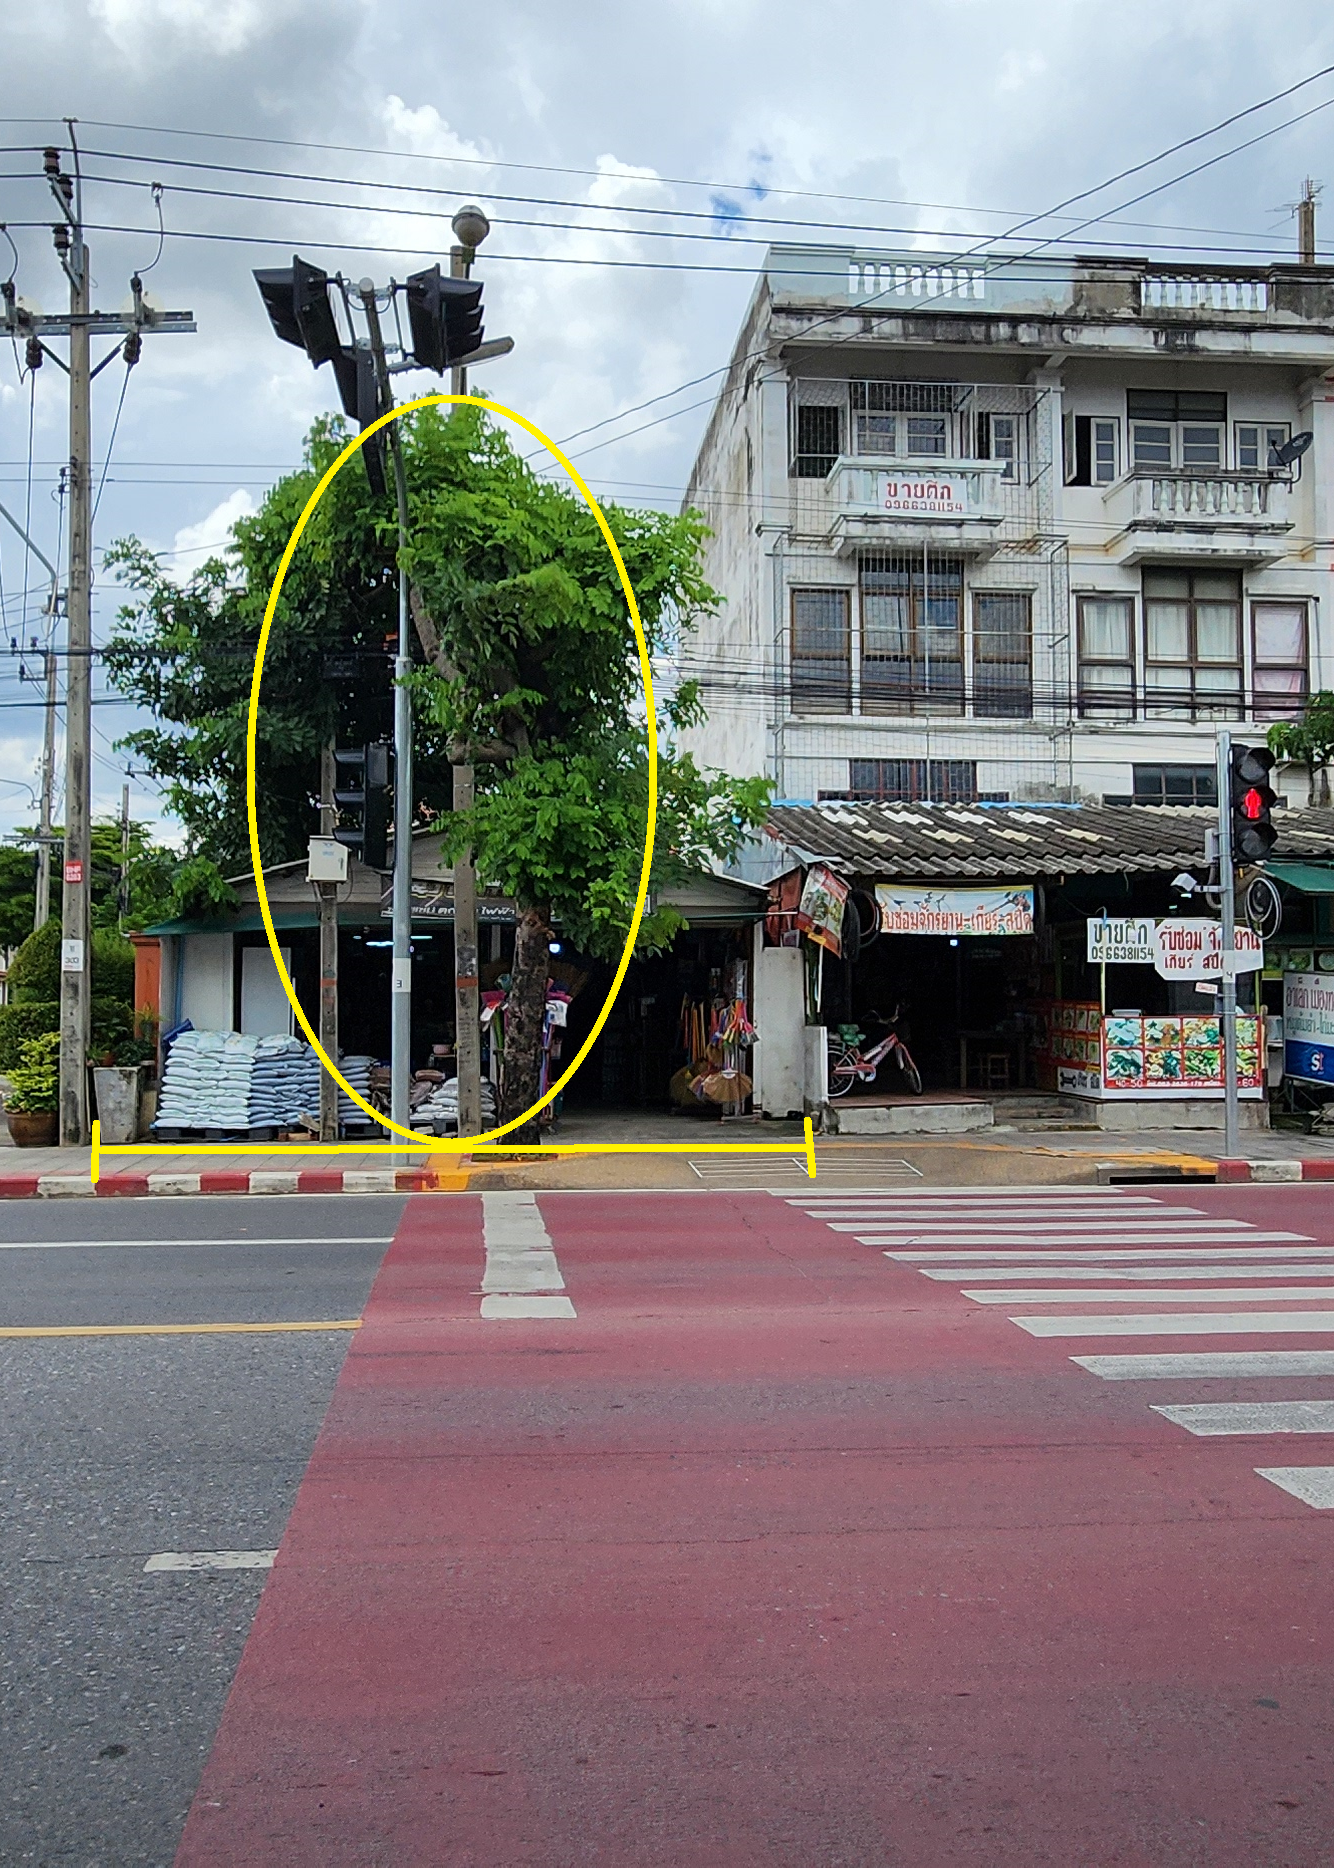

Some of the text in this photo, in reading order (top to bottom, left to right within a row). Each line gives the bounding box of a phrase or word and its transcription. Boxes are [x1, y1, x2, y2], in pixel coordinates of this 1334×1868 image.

[1094, 919, 1148, 945] ขายก
[1208, 926, 1261, 951] จัยาน
[1203, 952, 1224, 969] สปี
